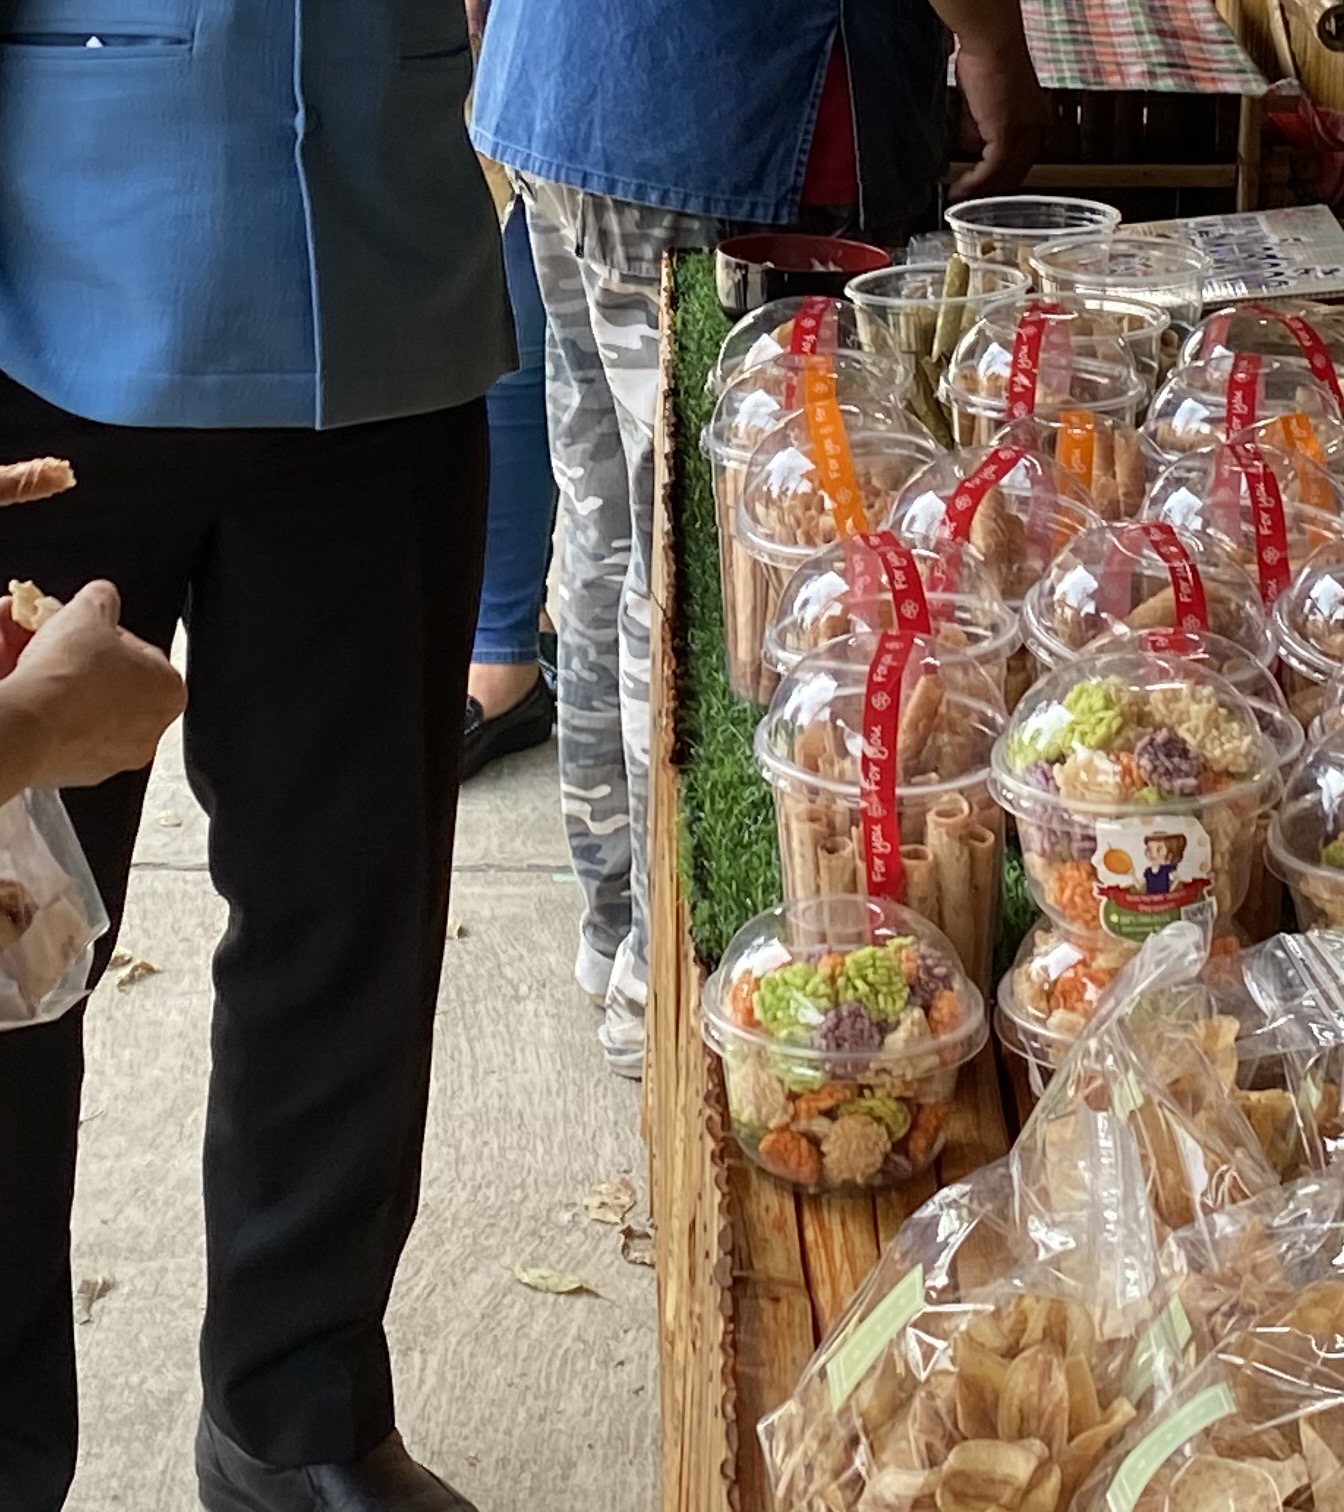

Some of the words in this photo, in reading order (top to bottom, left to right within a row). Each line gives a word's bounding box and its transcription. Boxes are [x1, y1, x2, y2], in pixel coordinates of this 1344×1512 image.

[1256, 481, 1276, 508] you
[1259, 509, 1274, 535] For
[866, 761, 881, 791] For
[870, 823, 892, 854] you
[871, 855, 887, 883] For
